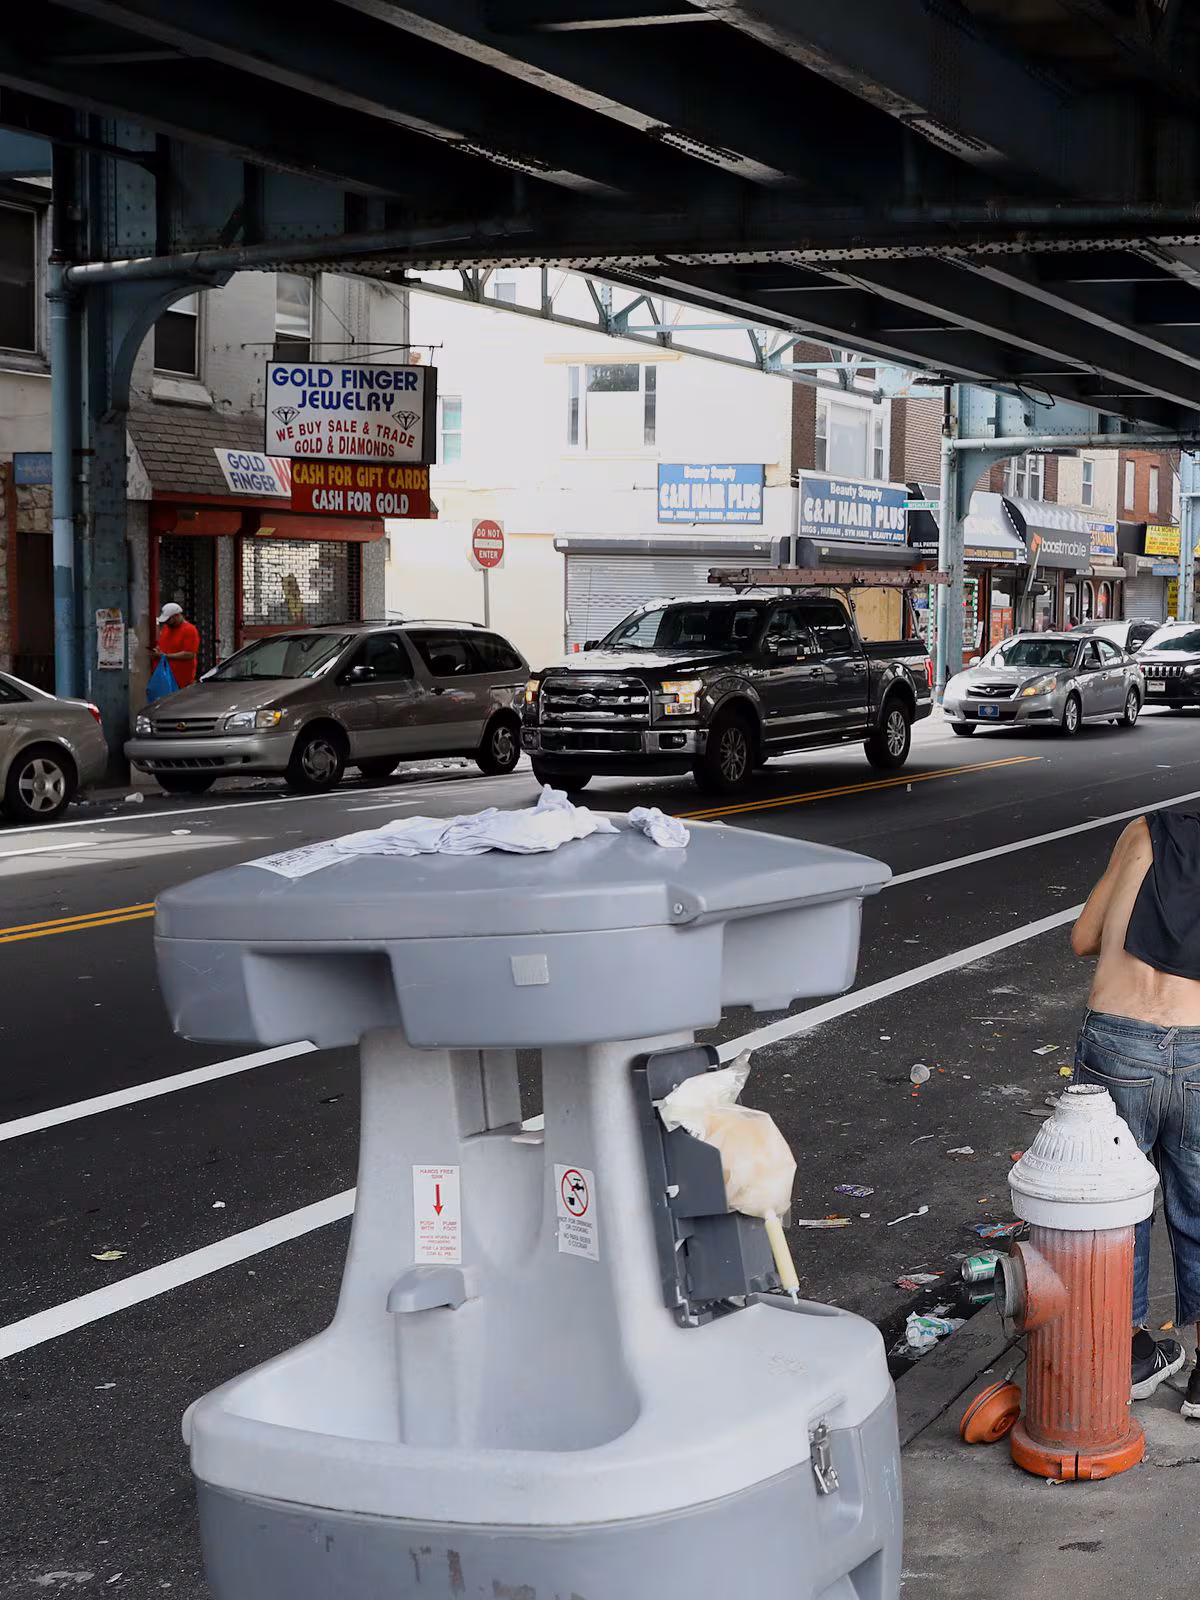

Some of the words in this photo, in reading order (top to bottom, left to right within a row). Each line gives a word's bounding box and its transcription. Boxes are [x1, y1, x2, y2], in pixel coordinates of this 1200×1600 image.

[272, 367, 333, 388] GOLD
[341, 370, 418, 391] FINGER
[298, 390, 394, 412] JEWELRY
[275, 427, 294, 442] WE
[300, 421, 322, 436] BUY
[328, 420, 357, 433] SALE
[362, 422, 369, 435] &
[376, 424, 415, 448] TRADE
[295, 437, 322, 454] GOLD
[327, 438, 334, 454] &
[339, 437, 395, 457] DIAMONDS
[227, 452, 265, 472] GOLD
[231, 471, 278, 493] FINGER
[293, 464, 324, 486] CASH
[329, 465, 352, 487] FOR
[357, 467, 383, 489] GIFT
[388, 468, 428, 491] CARDS
[312, 489, 343, 511] CASH
[347, 492, 371, 513] FOR
[376, 493, 409, 514] GOLD
[691, 483, 726, 509] HAIR
[728, 483, 761, 509] PLUS
[830, 482, 857, 499] Beauty
[858, 486, 883, 502] Supply
[838, 500, 872, 527] HAIR
[875, 505, 905, 530] PLUS
[476, 528, 486, 537] DO
[487, 529, 500, 538] NOT
[872, 530, 893, 540] BEAUTY
[479, 550, 499, 559] ENTER
